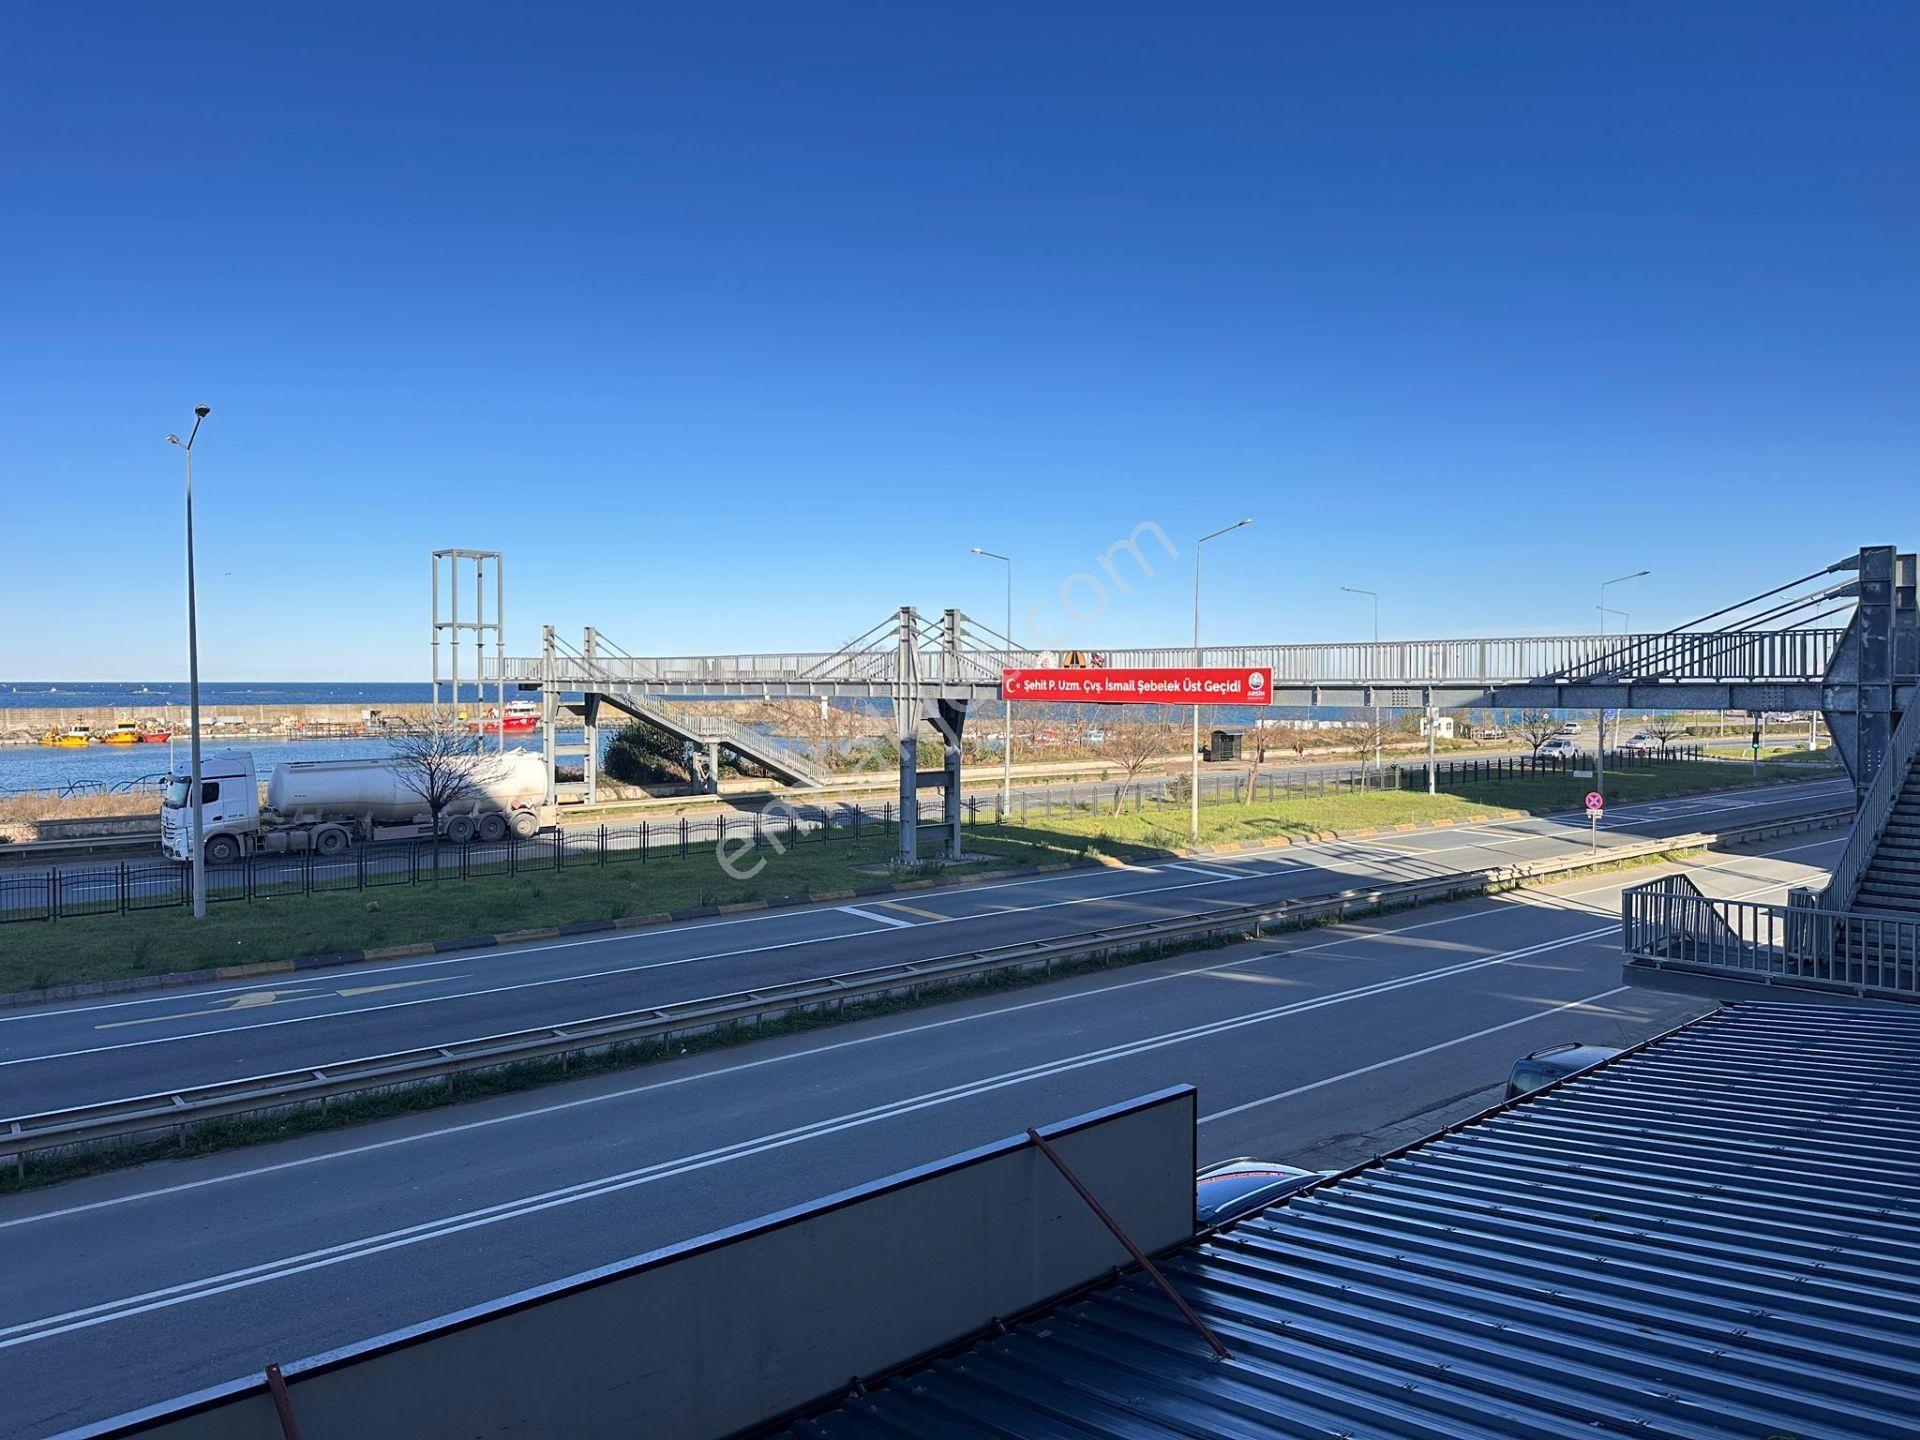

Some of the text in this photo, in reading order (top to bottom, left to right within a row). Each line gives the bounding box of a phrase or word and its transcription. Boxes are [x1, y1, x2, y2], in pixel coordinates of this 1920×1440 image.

[1024, 677, 1241, 695] Şehit P. Uzm. Çvş. İsmail Şebelek Üst Geçidi
